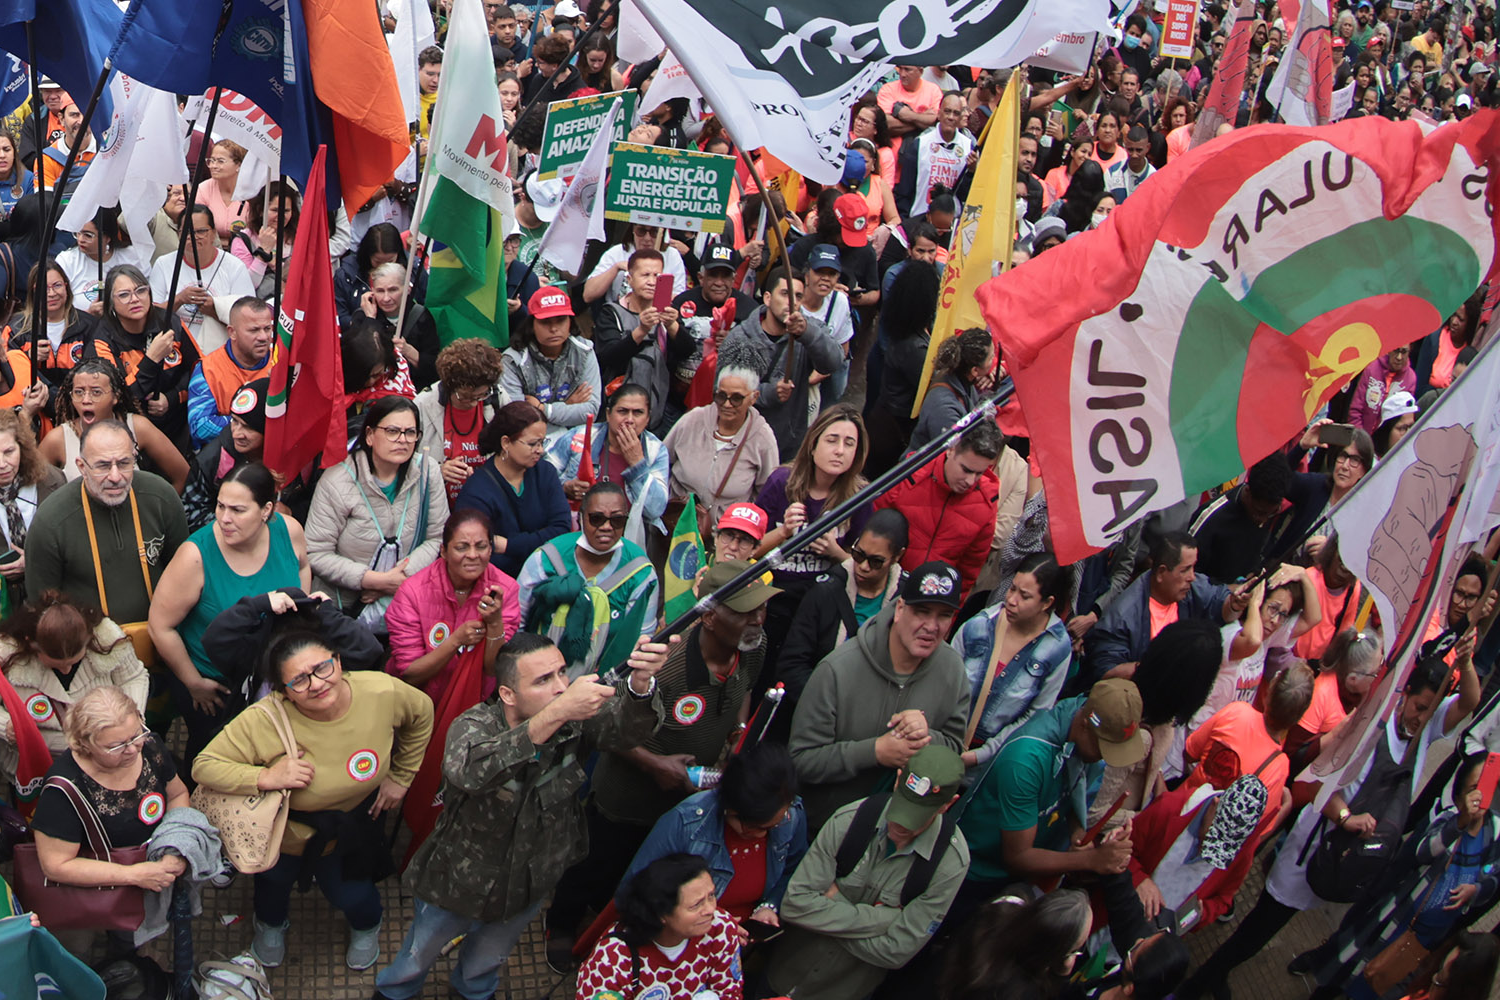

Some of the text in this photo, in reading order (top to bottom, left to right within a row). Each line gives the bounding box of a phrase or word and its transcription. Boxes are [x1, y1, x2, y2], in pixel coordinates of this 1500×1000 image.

[1171, 2, 1194, 14] TAXAÇÃO
[1175, 13, 1187, 22] DOS
[1171, 21, 1188, 31] SUPER
[220, 110, 246, 128] Direito
[253, 130, 281, 157] Moradi
[442, 144, 488, 185] Movimento
[930, 164, 951, 177] FIM
[626, 162, 718, 185] TRANSIÇÃO
[620, 179, 719, 202] ENERGÉTICA
[613, 194, 722, 215] JUSTA E POPULAR
[712, 246, 733, 260] CAT
[540, 293, 565, 306] CUT
[731, 506, 760, 523] CUT
